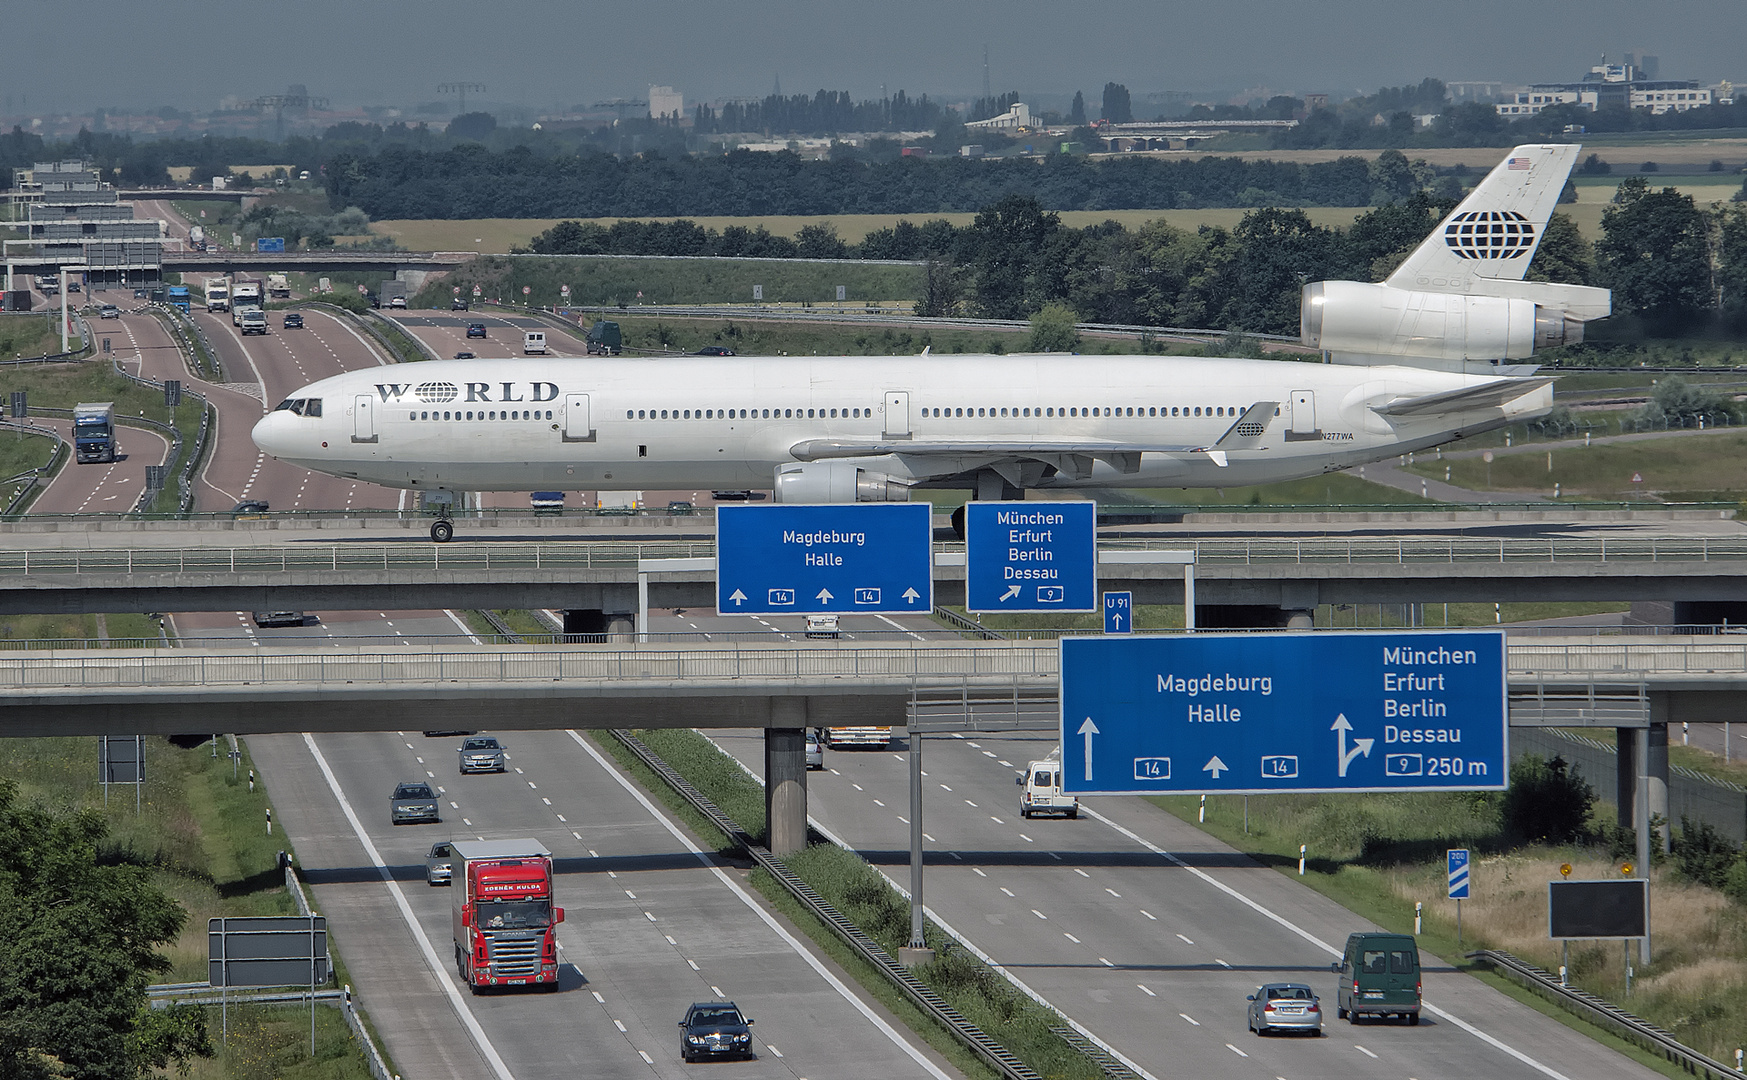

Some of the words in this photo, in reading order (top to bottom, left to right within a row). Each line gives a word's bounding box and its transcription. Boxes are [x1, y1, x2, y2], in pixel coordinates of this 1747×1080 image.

[1321, 432, 1354, 440] N277WA
[997, 511, 1064, 525] München
[783, 529, 865, 547] Magdeburg
[1009, 529, 1052, 543] Erfurt
[805, 552, 843, 566] Halle
[1008, 547, 1053, 561] Berlin
[1004, 566, 1058, 580] Dessau
[775, 592, 787, 602] 14
[862, 591, 874, 600] 14
[1047, 591, 1054, 600] 9
[1106, 598, 1115, 609] U
[1117, 598, 1128, 608] 91
[1383, 646, 1476, 665] München
[1157, 673, 1272, 697] Magdeburg
[1383, 672, 1445, 691] Erfurt
[1188, 703, 1241, 722] Halle
[1384, 699, 1446, 718] Berlin
[1384, 725, 1461, 743] Dessau
[1144, 761, 1160, 776] 14
[1271, 760, 1288, 774] 14
[1399, 758, 1408, 772] 9
[1427, 757, 1463, 776] 250
[1468, 761, 1487, 775] m
[1451, 852, 1465, 860] 200
